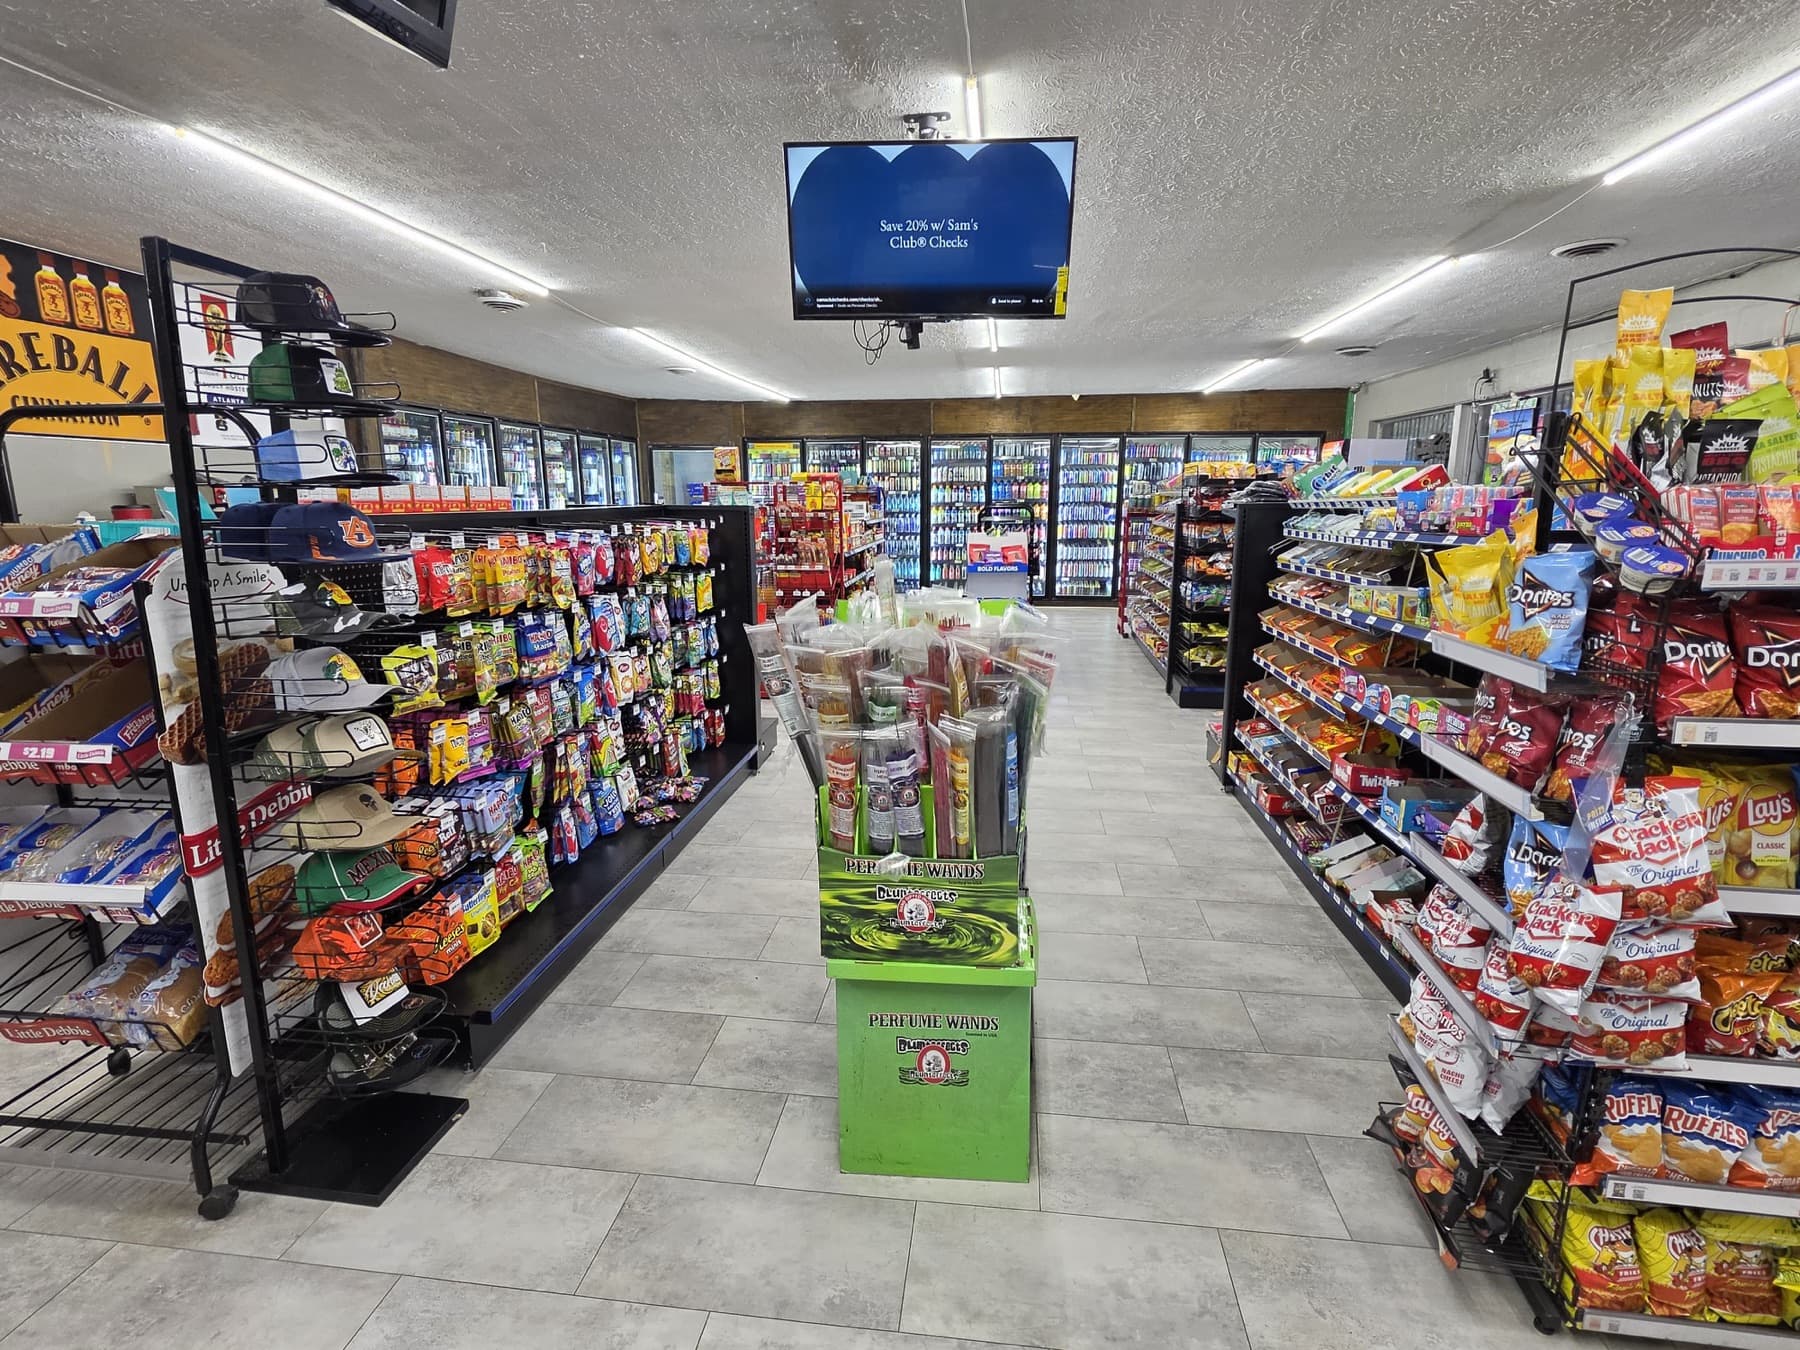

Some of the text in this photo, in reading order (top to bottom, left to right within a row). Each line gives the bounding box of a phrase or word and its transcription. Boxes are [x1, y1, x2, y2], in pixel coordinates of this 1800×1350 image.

[880, 217, 979, 232] Save 20% w/ Sam's
[928, 235, 969, 249] Checks
[212, 396, 245, 406] ATLANTA
[1311, 464, 1337, 492] Orbit
[222, 572, 233, 587] A
[236, 567, 267, 585] Smile
[1505, 584, 1575, 608] Doritos
[23, 746, 55, 759] $2.19
[1747, 794, 1792, 825] Lay's
[1612, 812, 1703, 843] Cracker
[1630, 836, 1685, 860] Jack
[1756, 842, 1786, 850] CLASSIC
[926, 862, 985, 880] WANDS
[1626, 860, 1700, 885] The Original
[1526, 902, 1595, 926] Cracker
[1524, 915, 1564, 937] Jack
[1515, 937, 1560, 960] Original
[1625, 940, 1681, 958] Original
[868, 1013, 1000, 1031] PERFUME WANDS
[1600, 1007, 1670, 1031] The Original
[4, 1025, 92, 1039] Little Debbie
[1439, 1073, 1464, 1086] CHEESE
[1440, 1067, 1465, 1080] NACHO
[1664, 1105, 1749, 1149] RUFFLES
